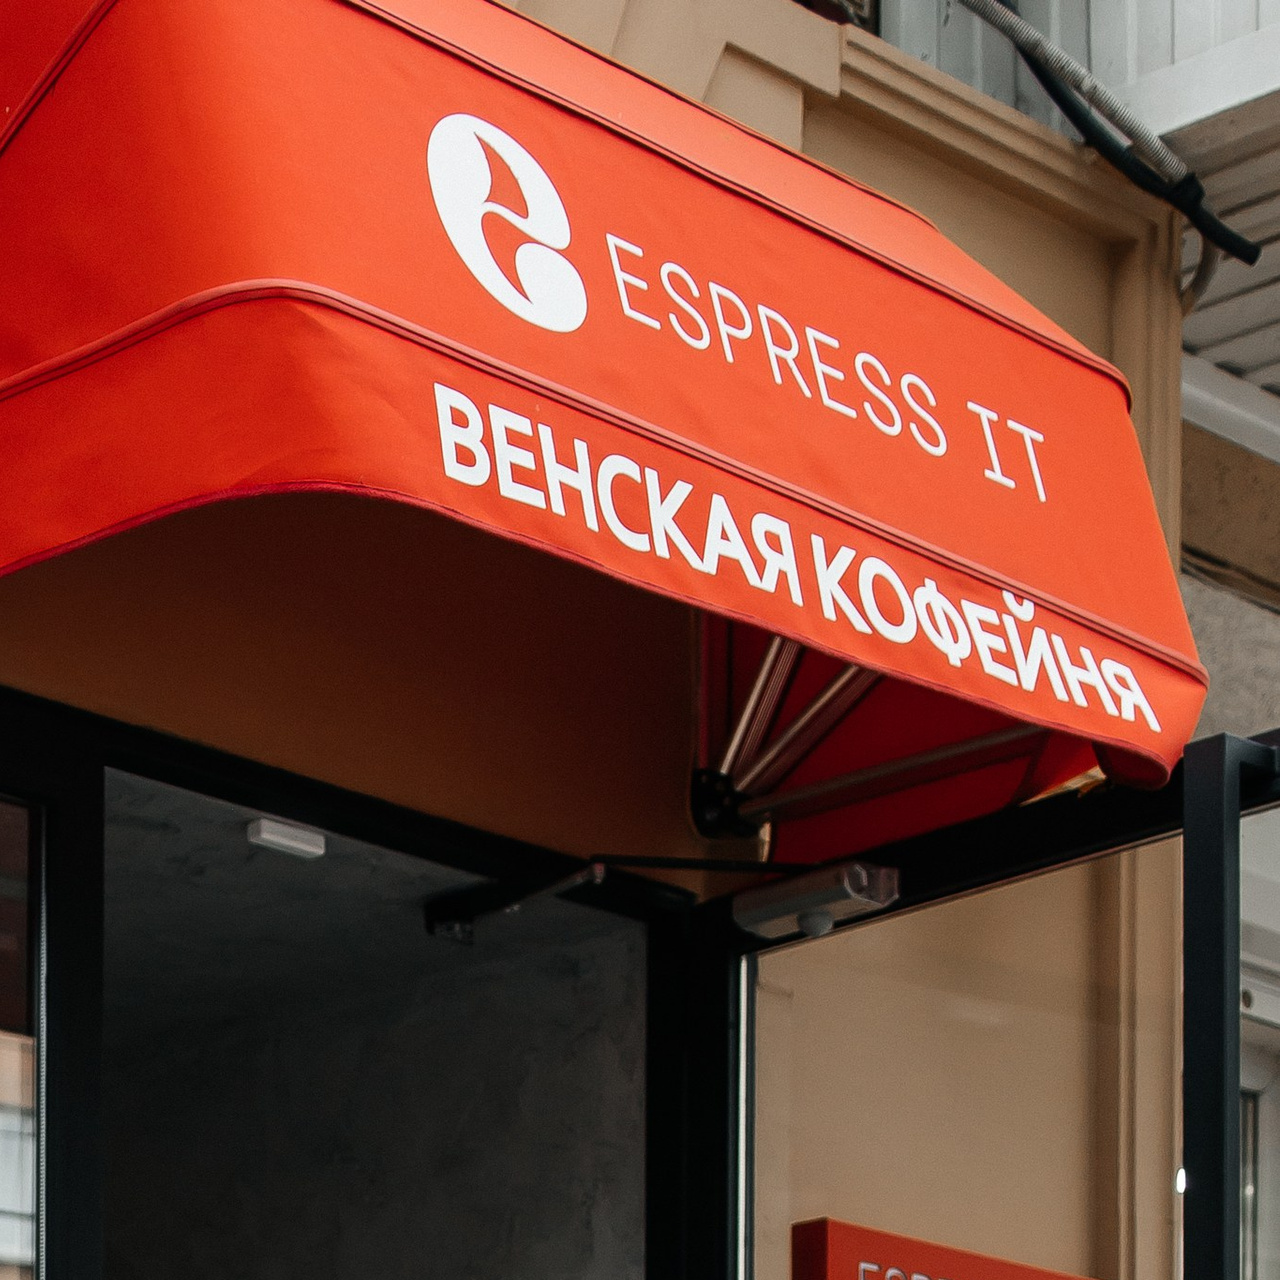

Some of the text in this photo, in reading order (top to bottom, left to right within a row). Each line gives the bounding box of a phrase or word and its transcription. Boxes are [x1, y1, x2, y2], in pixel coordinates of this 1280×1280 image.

[606, 232, 1046, 503] ESPRESS IT
[434, 382, 1162, 733] ВЕНСКАЯ КОФЕЙНЯ
